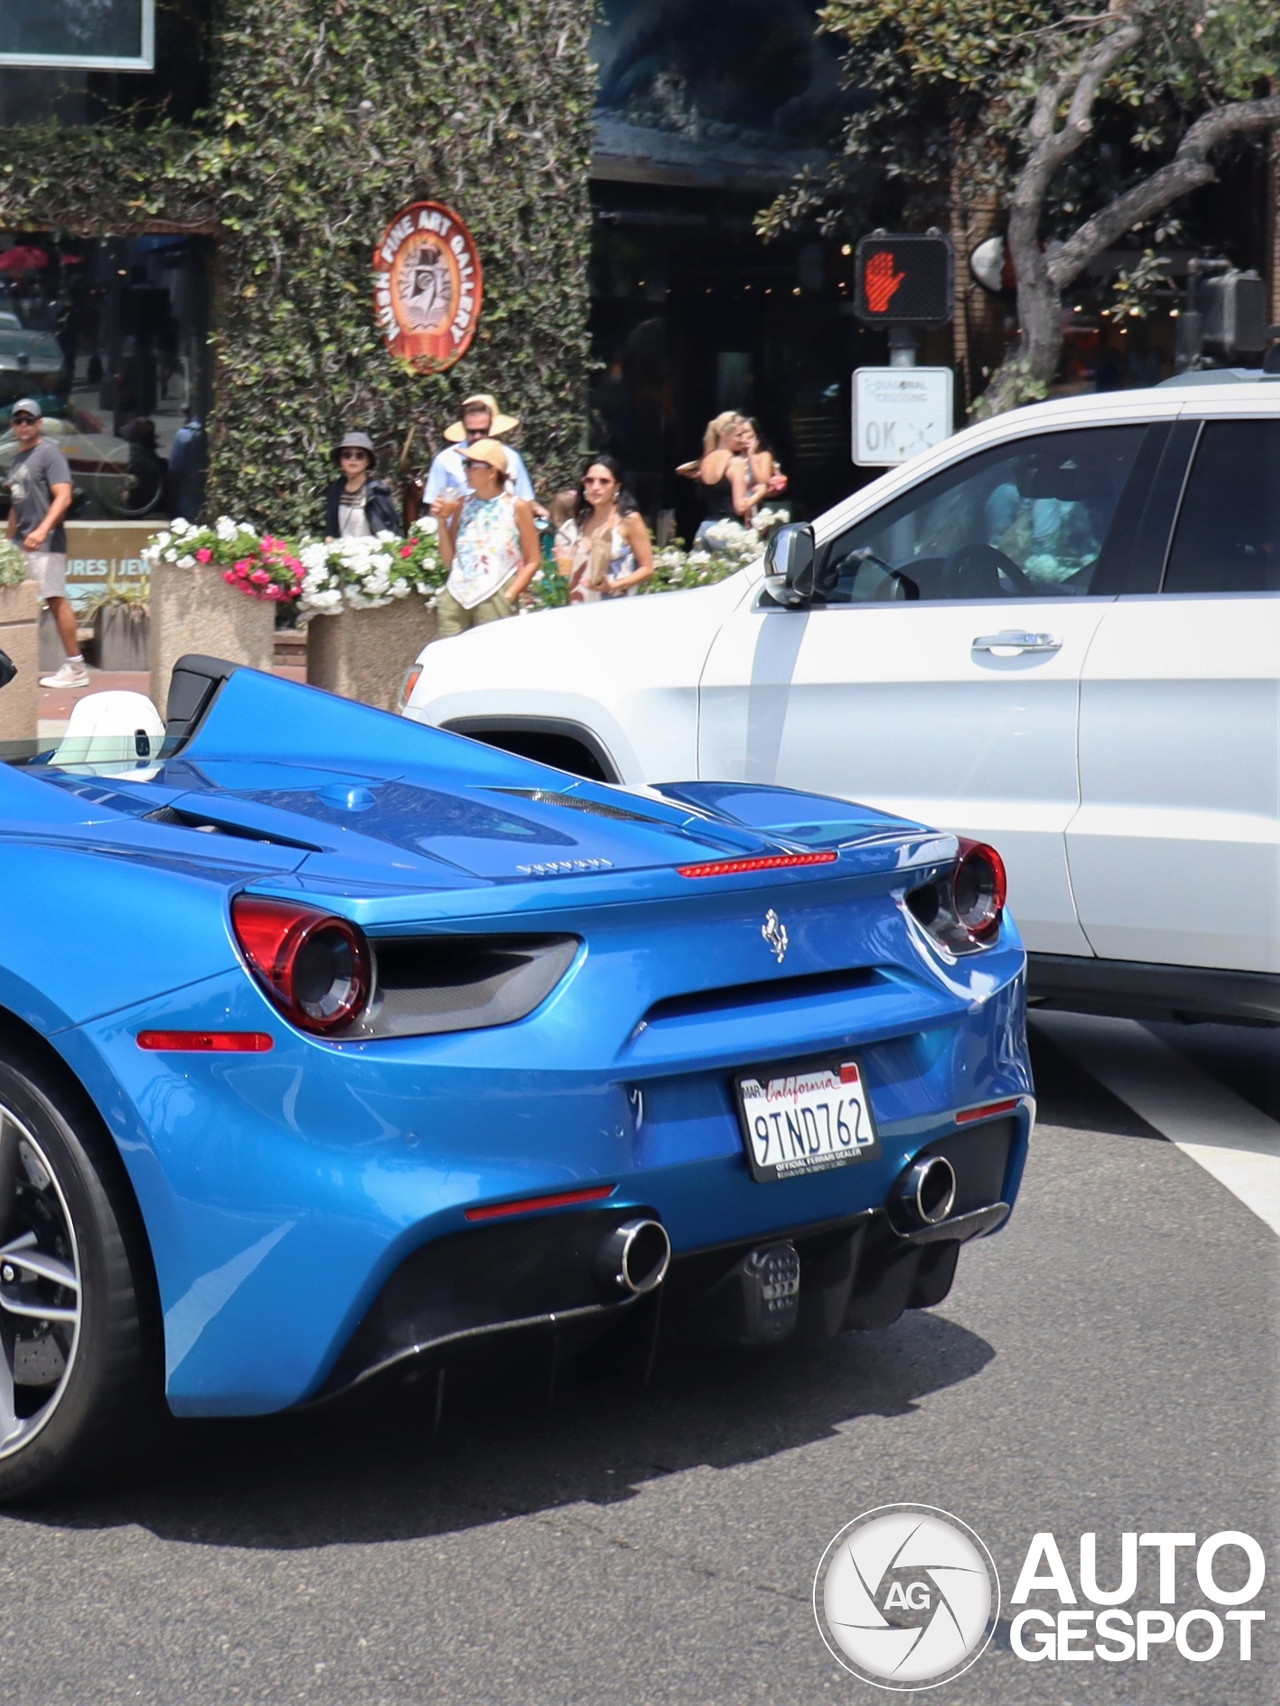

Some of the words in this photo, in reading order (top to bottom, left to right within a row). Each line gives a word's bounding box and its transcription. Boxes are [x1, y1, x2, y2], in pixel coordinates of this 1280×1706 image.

[380, 214, 415, 264] FINE
[418, 210, 453, 237] ART
[450, 235, 475, 344] GALLERY
[865, 421, 897, 451] OK
[66, 558, 109, 576] URES
[117, 558, 152, 576] JEW
[742, 1085, 762, 1099] MAR
[766, 1075, 842, 1105] California
[754, 1097, 869, 1164] 9TND762
[776, 1159, 807, 1172] OFFICIAL
[806, 1153, 835, 1166] FERRARI
[835, 1148, 862, 1160] DEALER
